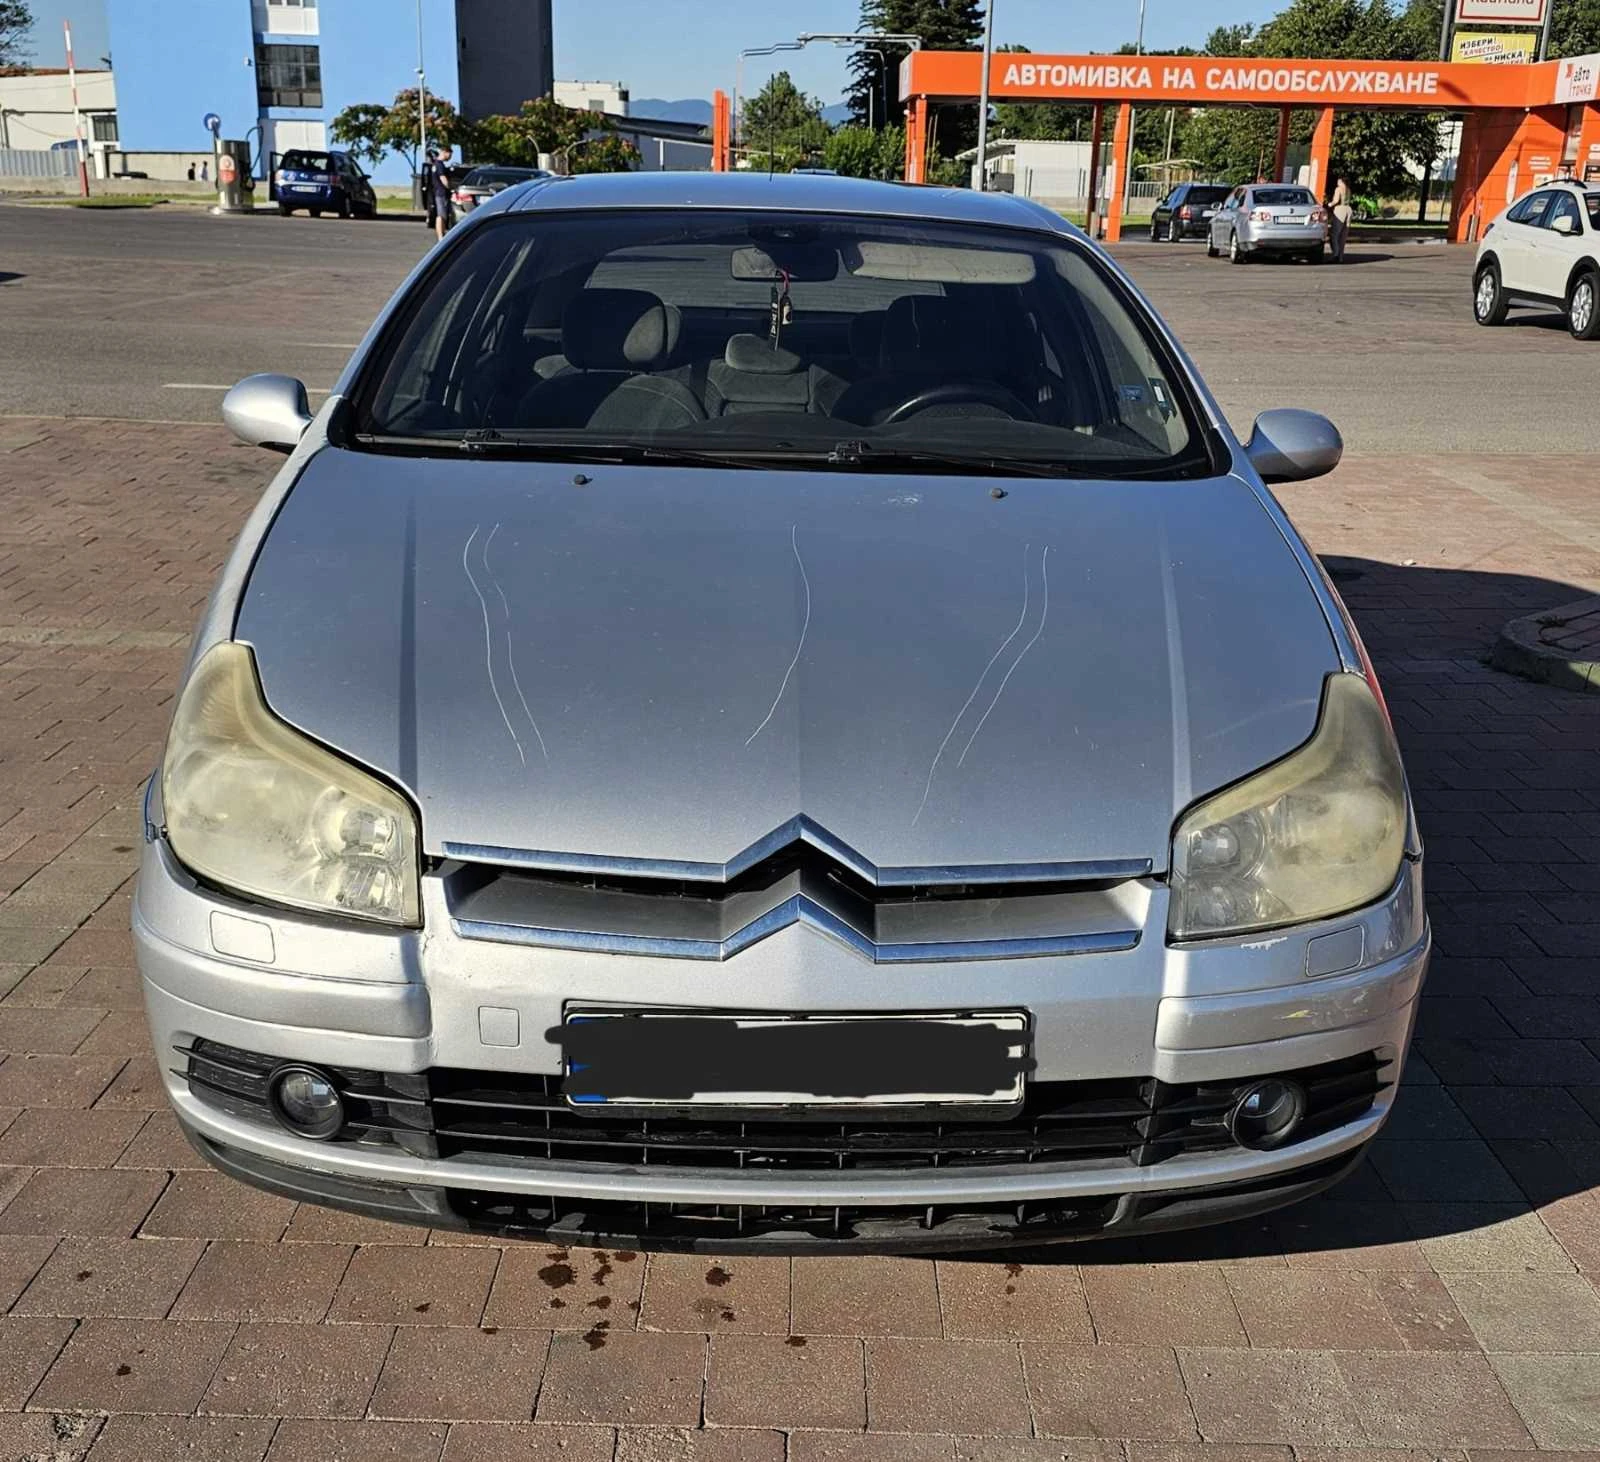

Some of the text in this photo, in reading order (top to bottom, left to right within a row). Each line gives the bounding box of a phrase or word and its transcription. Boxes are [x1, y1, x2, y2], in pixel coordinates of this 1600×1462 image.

[1460, 37, 1493, 49] ИЗБЕРИ
[1494, 51, 1522, 62] НИСКА
[1003, 64, 1439, 94] АВТОМИВКА НА САМООБСЛУЖВАНЕ
